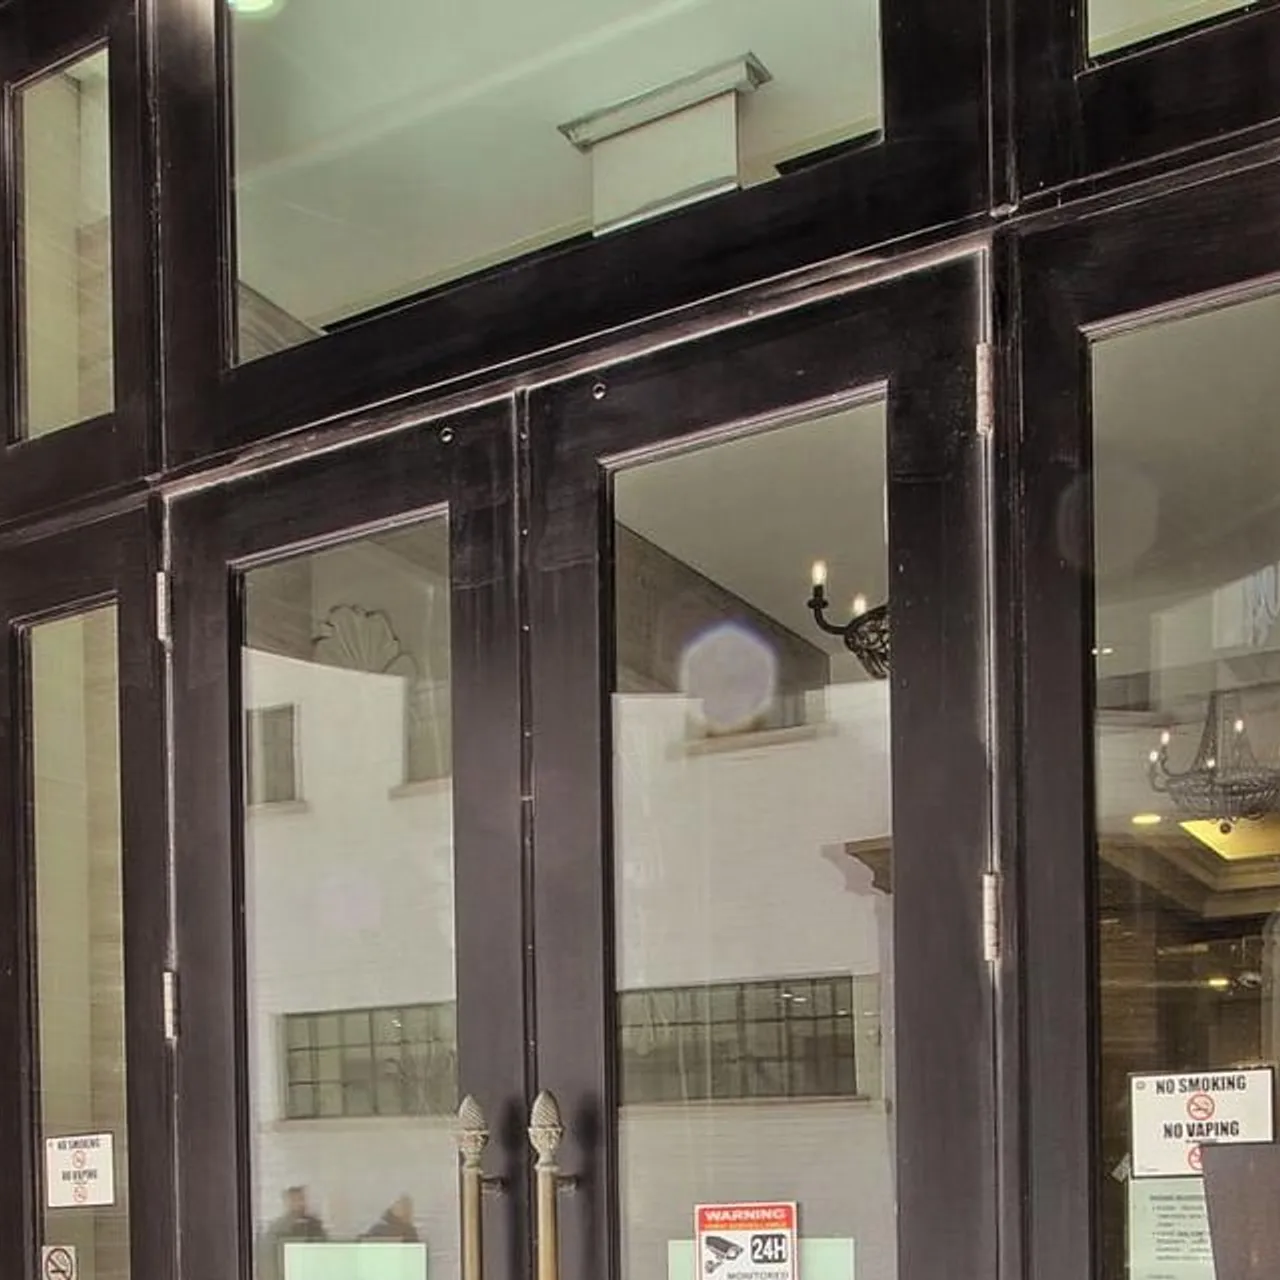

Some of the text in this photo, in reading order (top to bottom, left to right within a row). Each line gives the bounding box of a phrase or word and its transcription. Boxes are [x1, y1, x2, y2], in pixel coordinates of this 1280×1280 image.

[1156, 1074, 1247, 1095] NO SMOKING
[1163, 1120, 1240, 1139] NO VAPING
[704, 1208, 786, 1221] WARNING
[752, 1238, 786, 1261] 24H
